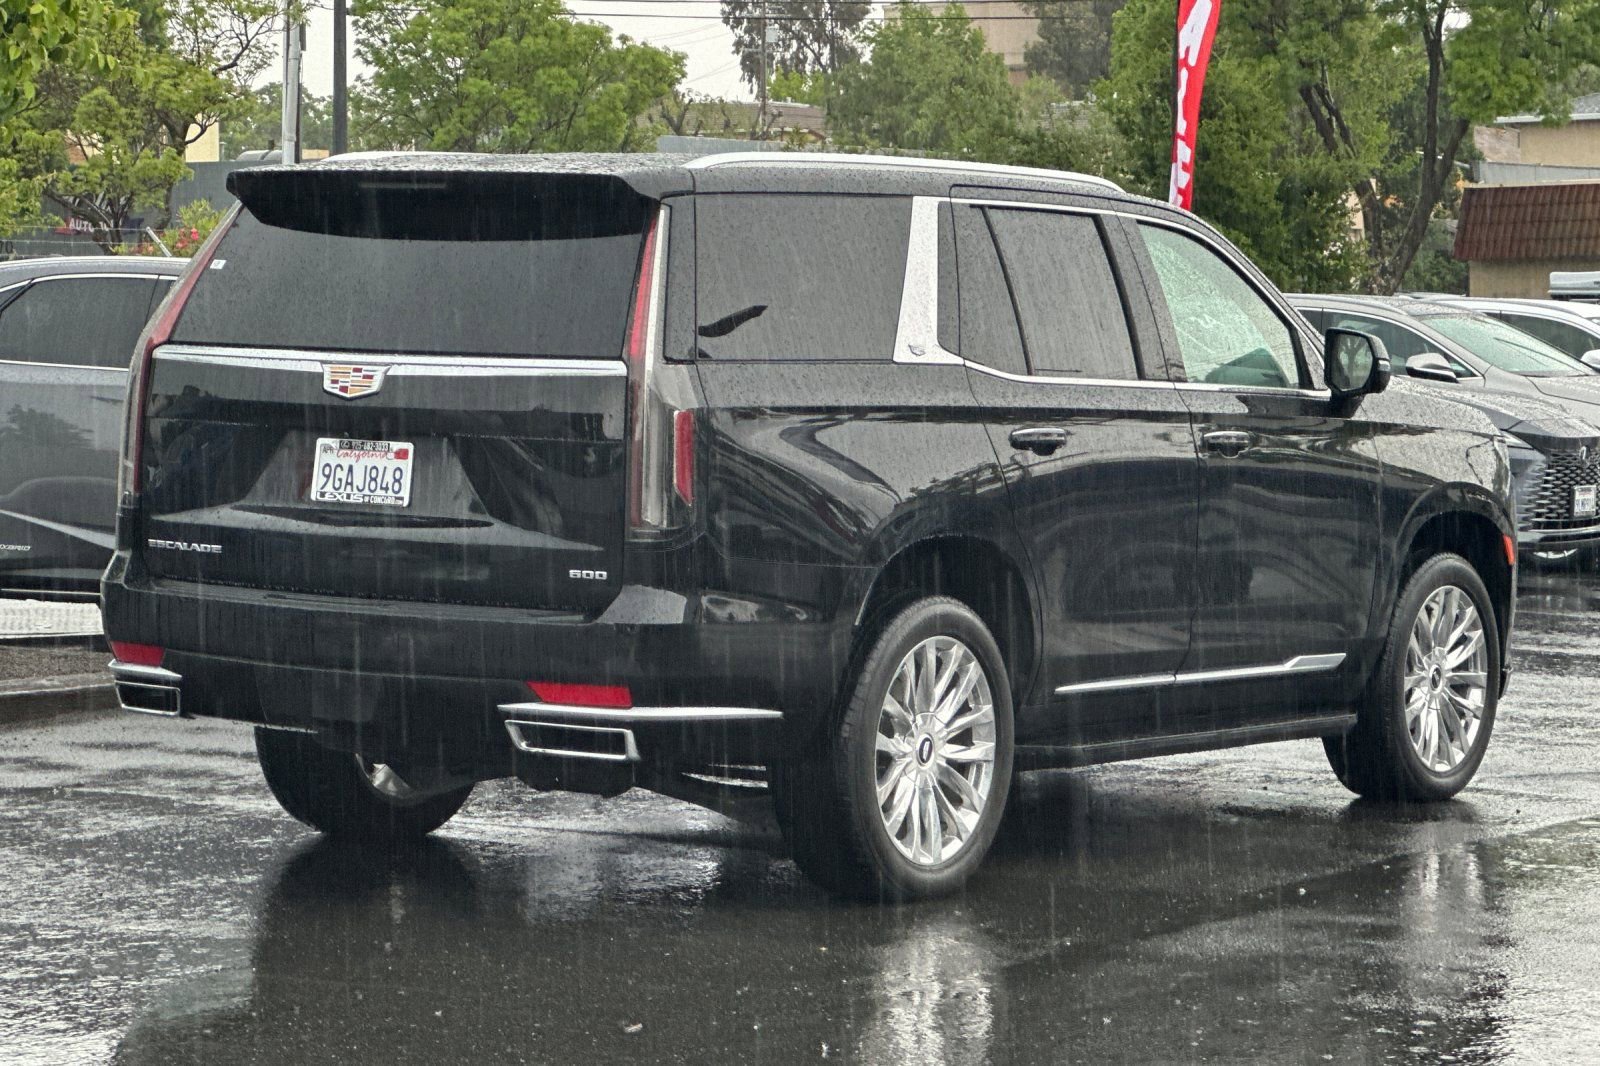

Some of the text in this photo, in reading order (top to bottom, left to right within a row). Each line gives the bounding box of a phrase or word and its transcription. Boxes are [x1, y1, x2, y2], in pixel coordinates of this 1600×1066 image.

[320, 462, 403, 494] 9GAJ848
[316, 491, 364, 503] LEXUS
[148, 538, 222, 553] ESCALADE
[568, 569, 607, 580] 600
